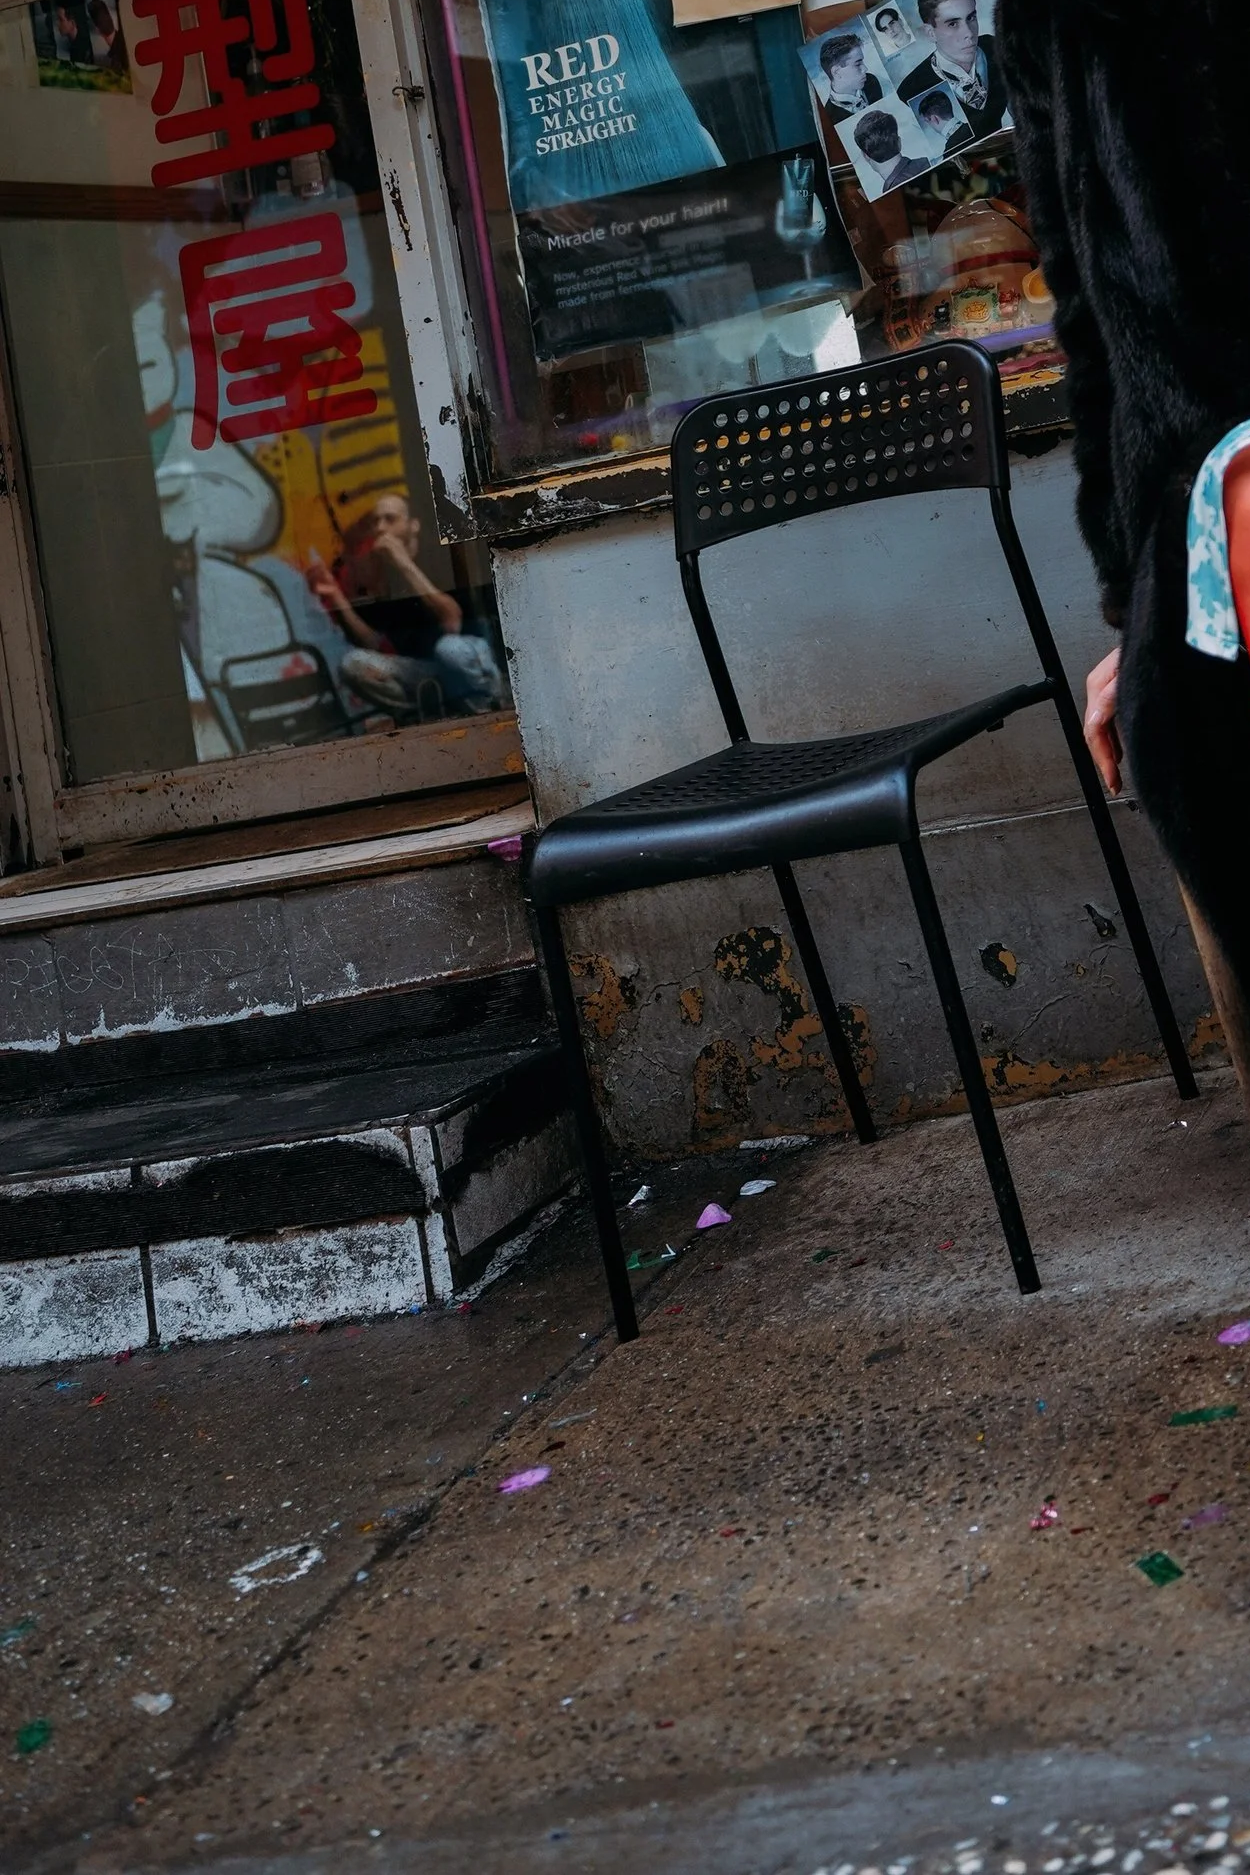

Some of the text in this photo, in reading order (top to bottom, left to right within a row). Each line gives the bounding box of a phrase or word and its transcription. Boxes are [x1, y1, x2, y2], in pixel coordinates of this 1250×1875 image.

[520, 33, 620, 92] RED
[528, 71, 626, 115] ENERGY
[541, 95, 623, 133] MAGIC
[535, 113, 637, 157] STRAIGHT
[547, 226, 605, 251] Miracle
[609, 221, 635, 237] for
[639, 210, 677, 235] your
